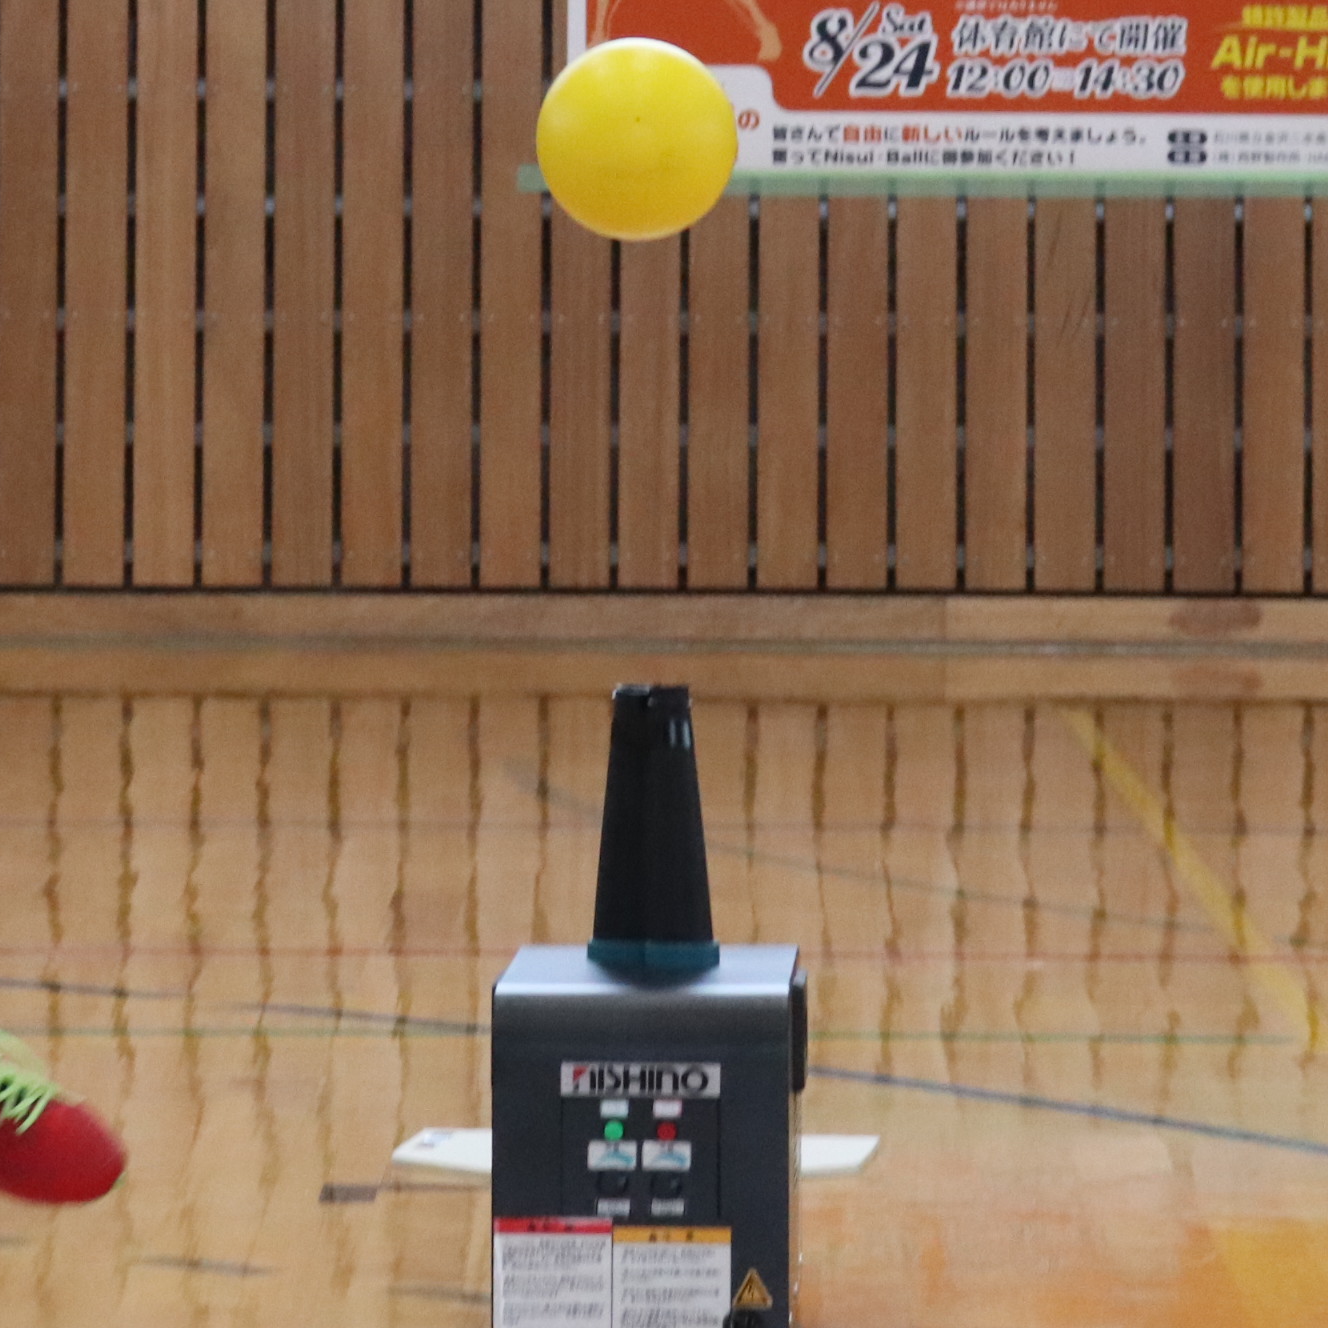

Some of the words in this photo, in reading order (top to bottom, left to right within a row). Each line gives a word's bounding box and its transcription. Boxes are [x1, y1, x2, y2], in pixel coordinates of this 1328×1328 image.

[876, 3, 933, 36] Sat
[952, 14, 1186, 56] 体育館にて開催
